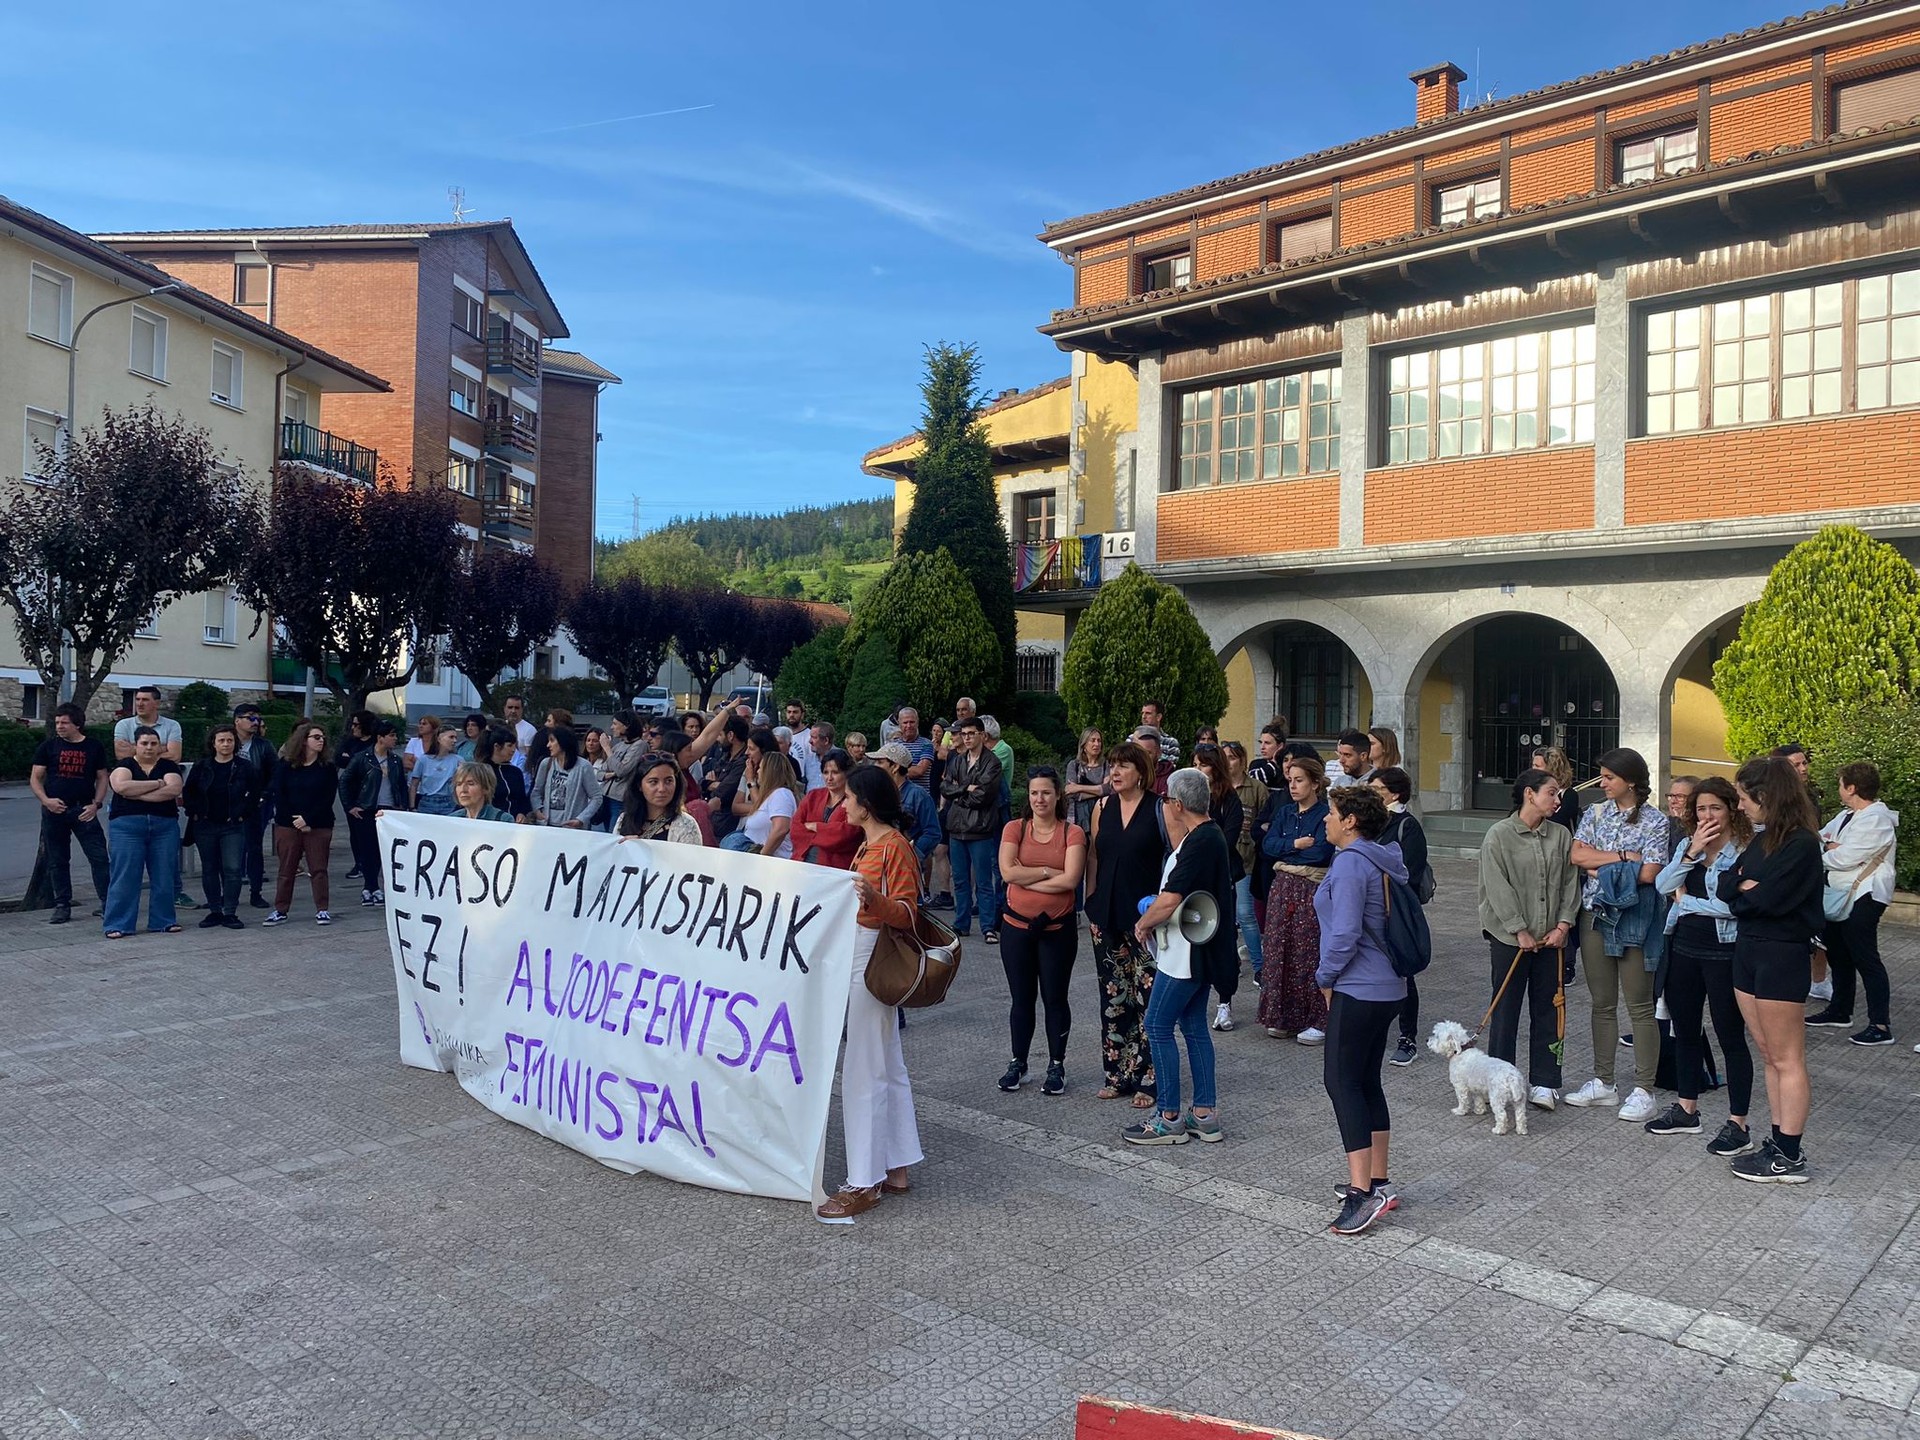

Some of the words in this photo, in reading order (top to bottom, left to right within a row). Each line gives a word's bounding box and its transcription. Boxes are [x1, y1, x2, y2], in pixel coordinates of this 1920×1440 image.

[1106, 536, 1130, 553] 16
[390, 837, 519, 908] ERASO
[544, 852, 823, 975] MATXISTARIK
[505, 939, 804, 1086] AUTODEFENTSA
[500, 1031, 717, 1159] FEMINISTA!
